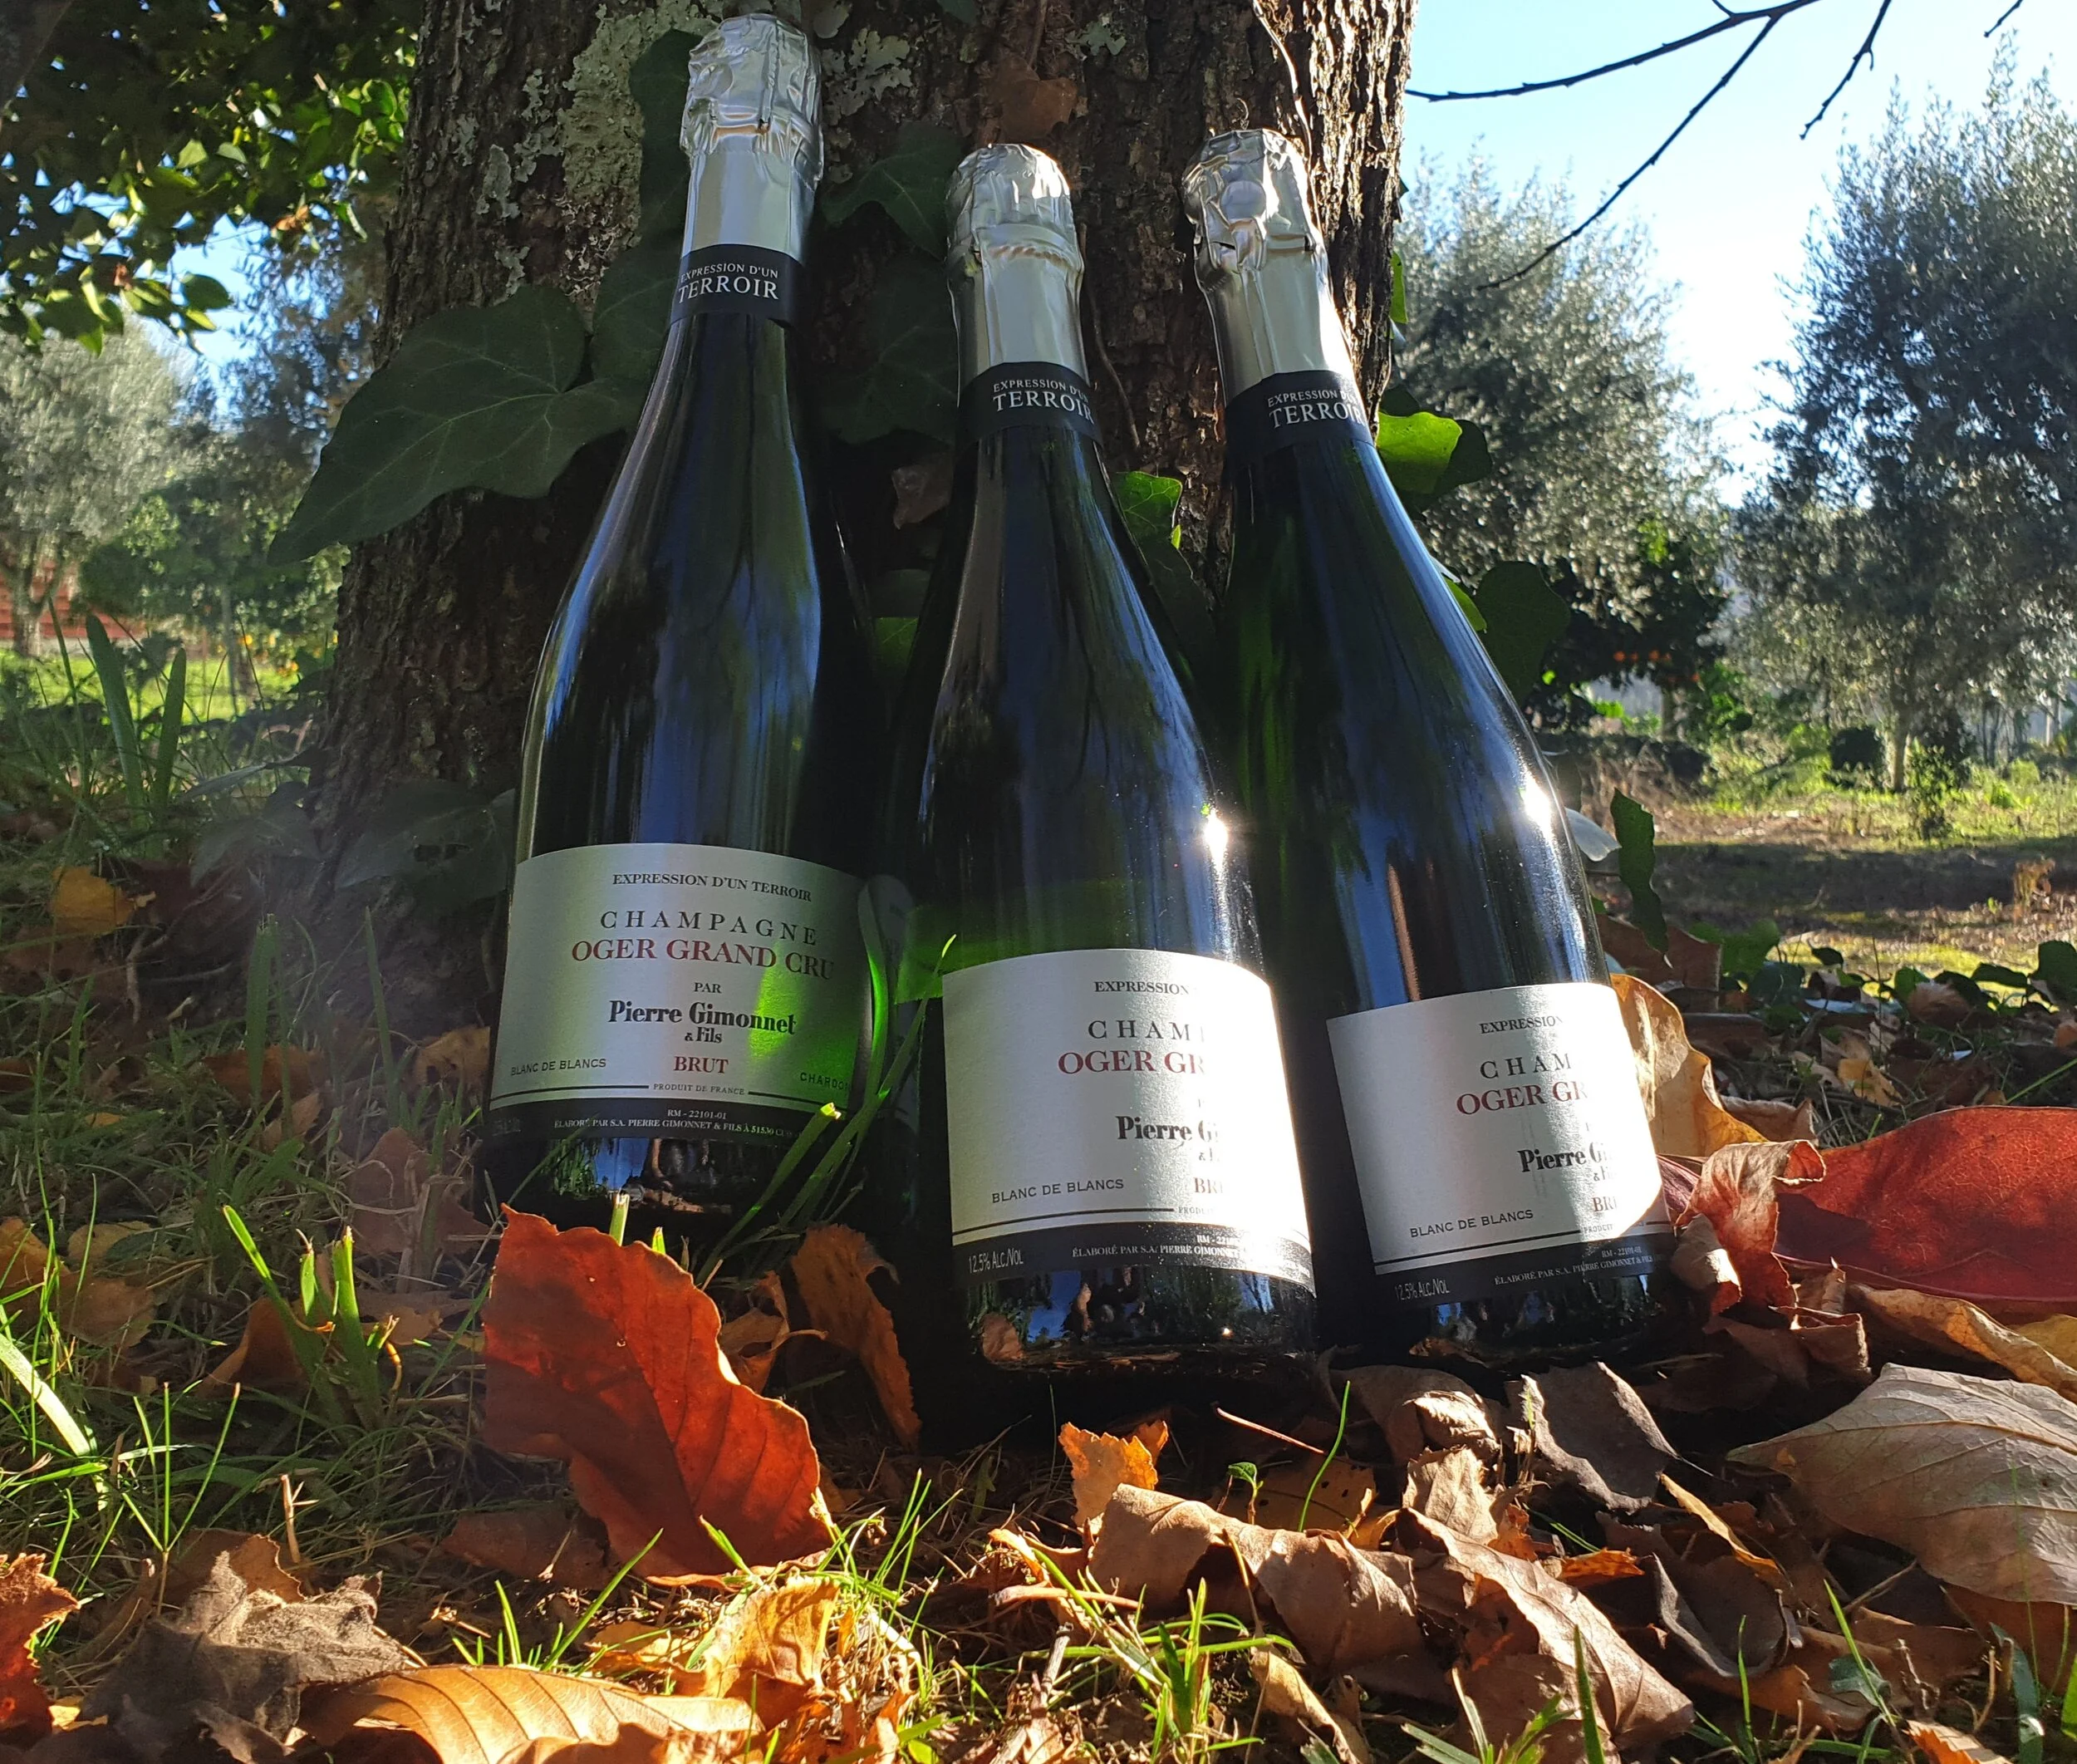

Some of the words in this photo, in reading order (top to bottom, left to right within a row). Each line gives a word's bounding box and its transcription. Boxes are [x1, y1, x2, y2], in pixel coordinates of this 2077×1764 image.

[680, 263, 745, 283] EXPRESSION
[749, 265, 778, 279] D'UN
[678, 276, 779, 304] TERROIR
[994, 379, 1066, 393] EXPRESSION
[993, 390, 1094, 425] TERROIR
[1268, 390, 1338, 407] EXPRESSION
[1269, 402, 1365, 428] TERROIR
[612, 873, 708, 887] EXPRESSION
[711, 876, 748, 891] D'UN
[752, 881, 812, 902] TERROIR
[600, 911, 817, 946] CHAMPAGNE
[572, 939, 657, 961] OGER
[666, 940, 777, 968] GRAND
[785, 951, 834, 980] CRU
[694, 982, 721, 994] PAR
[608, 1000, 682, 1024] Pierre
[689, 1002, 797, 1035] Gimonnet
[695, 1027, 722, 1044] Fils
[511, 1060, 539, 1076] BLANC
[542, 1060, 557, 1071] DE
[558, 1058, 606, 1070] BLANCS
[674, 1056, 729, 1074] BRUT
[1058, 1050, 1156, 1074] OGER
[653, 1083, 692, 1093] PRODUIT
[710, 1086, 744, 1098] FRANCE
[800, 1072, 848, 1090] CHARDO
[1456, 1084, 1547, 1115] OGER
[628, 1119, 660, 1128] PIERRE
[662, 1120, 711, 1129] GIMONNET
[723, 1123, 742, 1132] FILS
[1115, 1115, 1192, 1141] Pierre
[1517, 1149, 1587, 1172] Pierre
[992, 1186, 1037, 1204] BLANC
[1042, 1183, 1061, 1196] DE
[1067, 1178, 1124, 1192] BLANCS
[1410, 1222, 1454, 1238] BLANC
[1458, 1217, 1476, 1230] DE
[1481, 1209, 1534, 1226] BLANCS
[1072, 1245, 1118, 1257] ÉLABORÉ
[1160, 1245, 1193, 1254] PIERRE
[1495, 1271, 1536, 1285] ÉLABORÉ
[1538, 1270, 1554, 1279] PAR
[1573, 1263, 1599, 1273] PIERRE
[1600, 1256, 1635, 1269] GIMONNET
